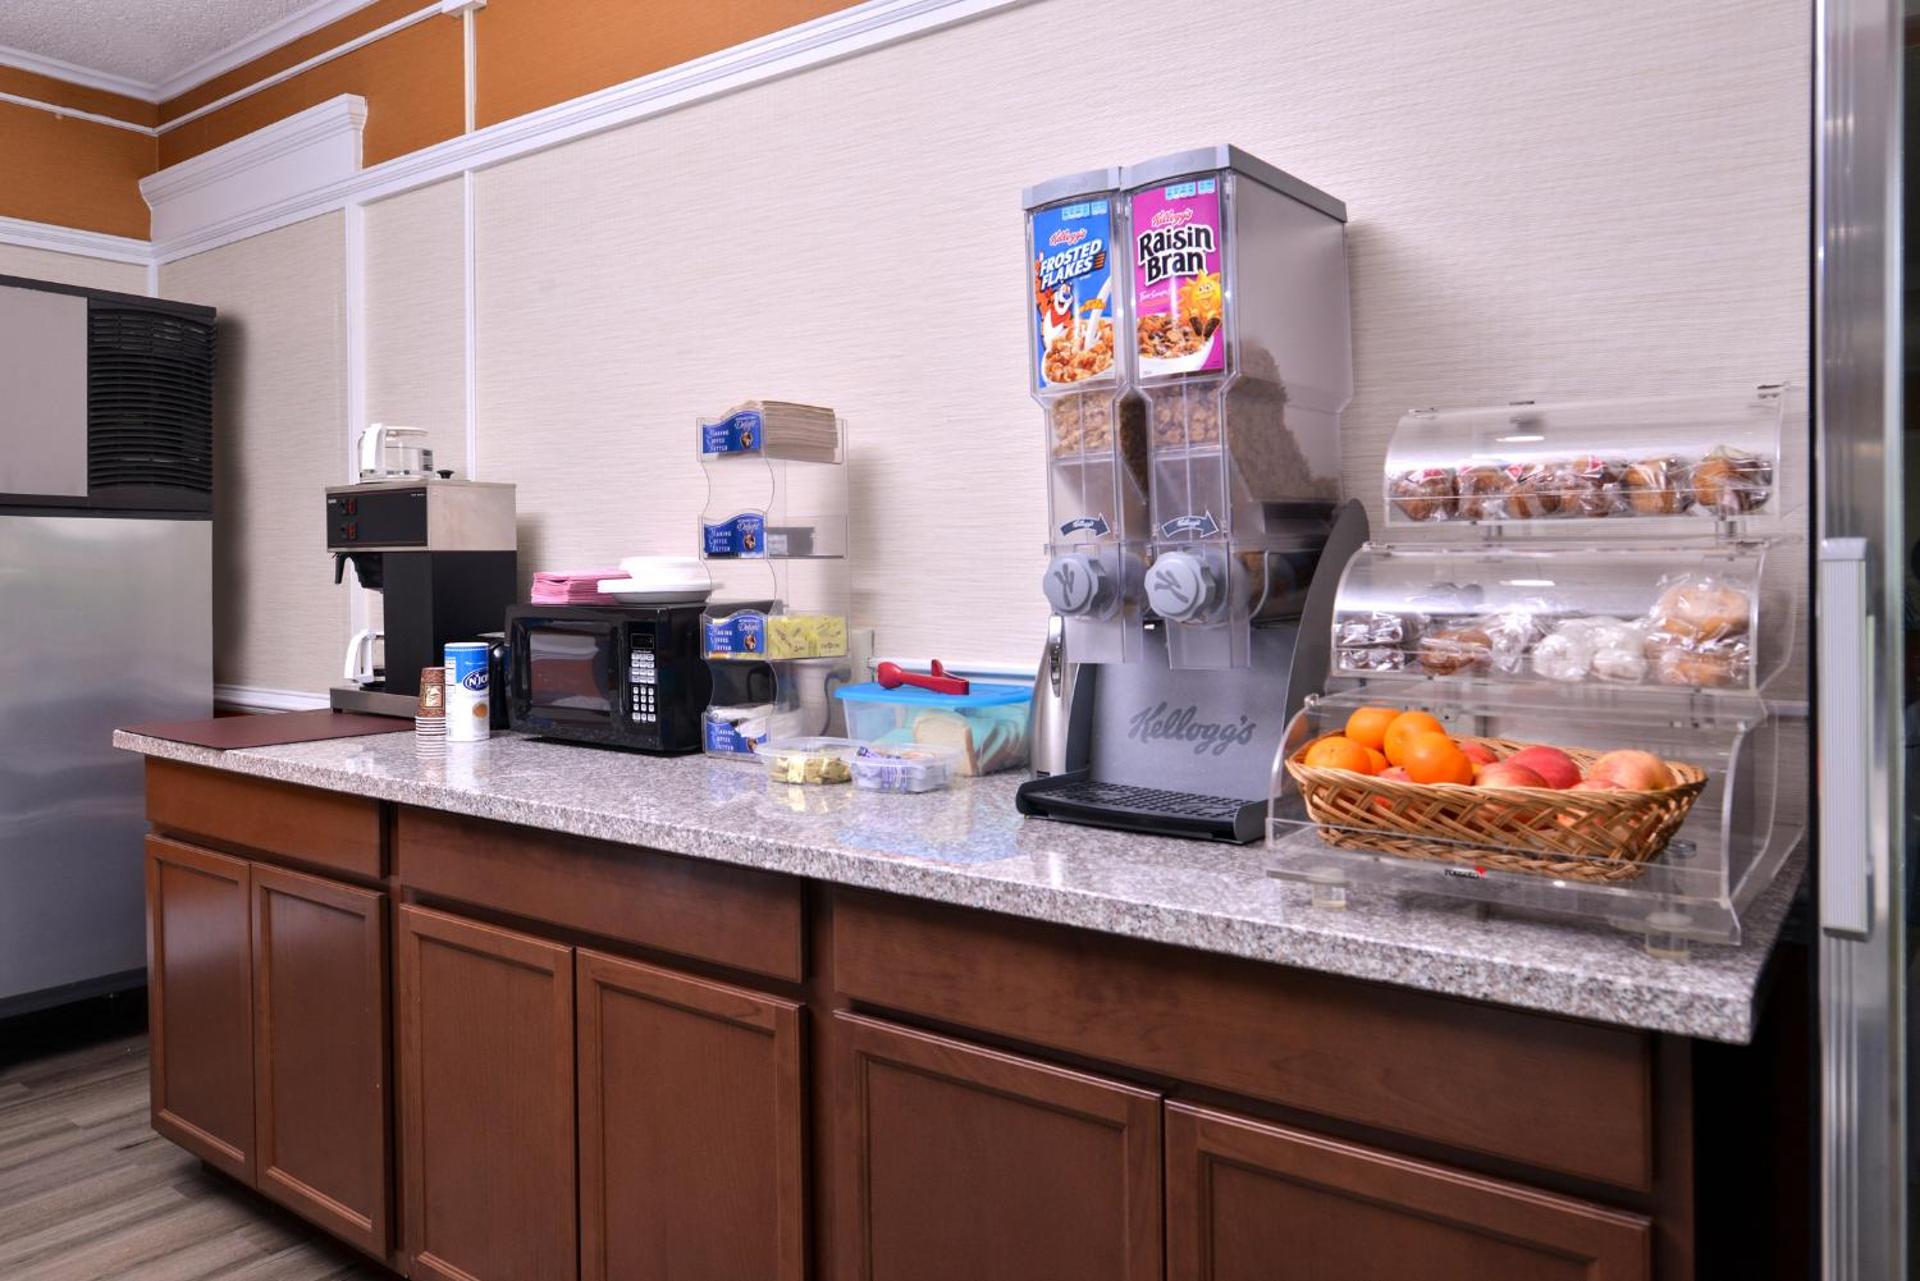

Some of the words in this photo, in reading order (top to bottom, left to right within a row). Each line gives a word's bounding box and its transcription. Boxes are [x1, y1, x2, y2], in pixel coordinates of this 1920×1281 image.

[1040, 239, 1102, 278] FROSTED
[1139, 225, 1212, 262] Raisin
[1041, 256, 1094, 291] FLAKES
[1146, 251, 1203, 282] Bran
[1128, 700, 1257, 757] Kellogg's
